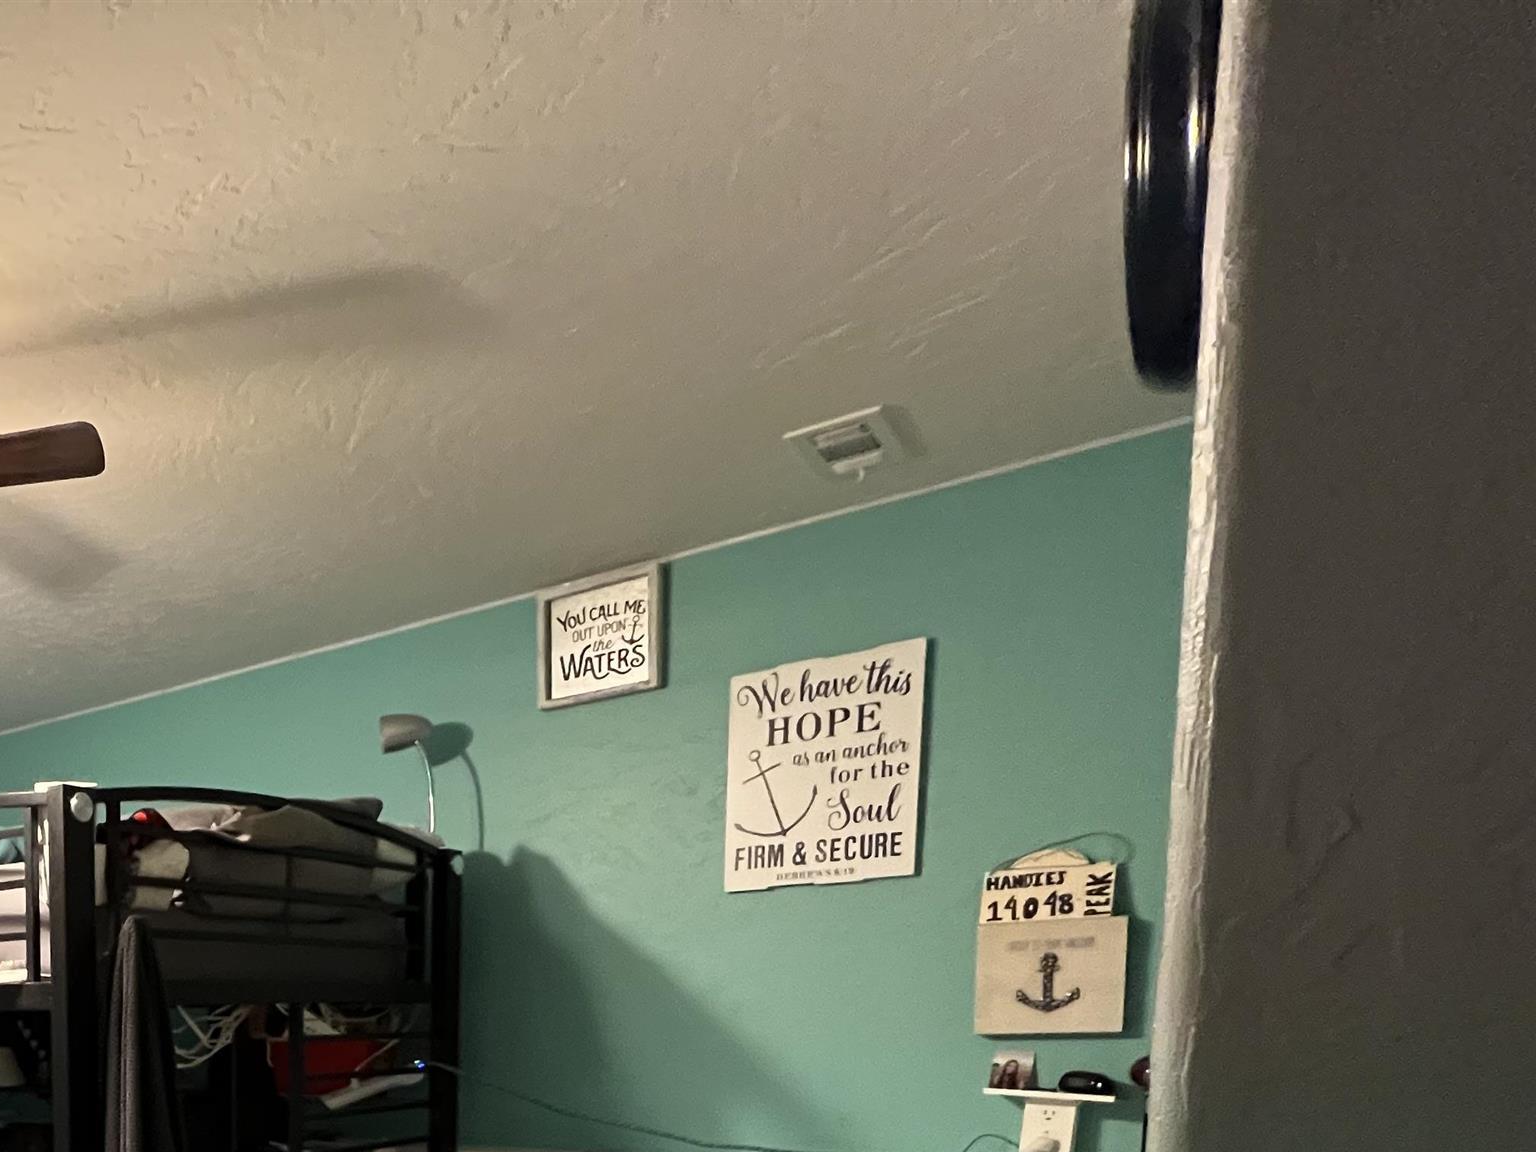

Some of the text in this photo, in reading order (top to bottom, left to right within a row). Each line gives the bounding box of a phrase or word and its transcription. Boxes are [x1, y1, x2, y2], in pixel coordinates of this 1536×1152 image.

[556, 599, 646, 631] YOU CALL ME
[572, 619, 626, 643] OUT UPON
[560, 644, 646, 681] WATERS
[592, 639, 615, 652] the
[737, 657, 912, 719] We have this
[766, 701, 882, 748] HOPE
[792, 732, 910, 767] as an anchor
[830, 760, 910, 785] for the
[826, 782, 902, 831] Soul
[734, 831, 904, 872] FIRM & SECURE
[985, 870, 1067, 891] HANDIES
[1083, 870, 1114, 917] PEAK
[986, 890, 1074, 922] 14048
